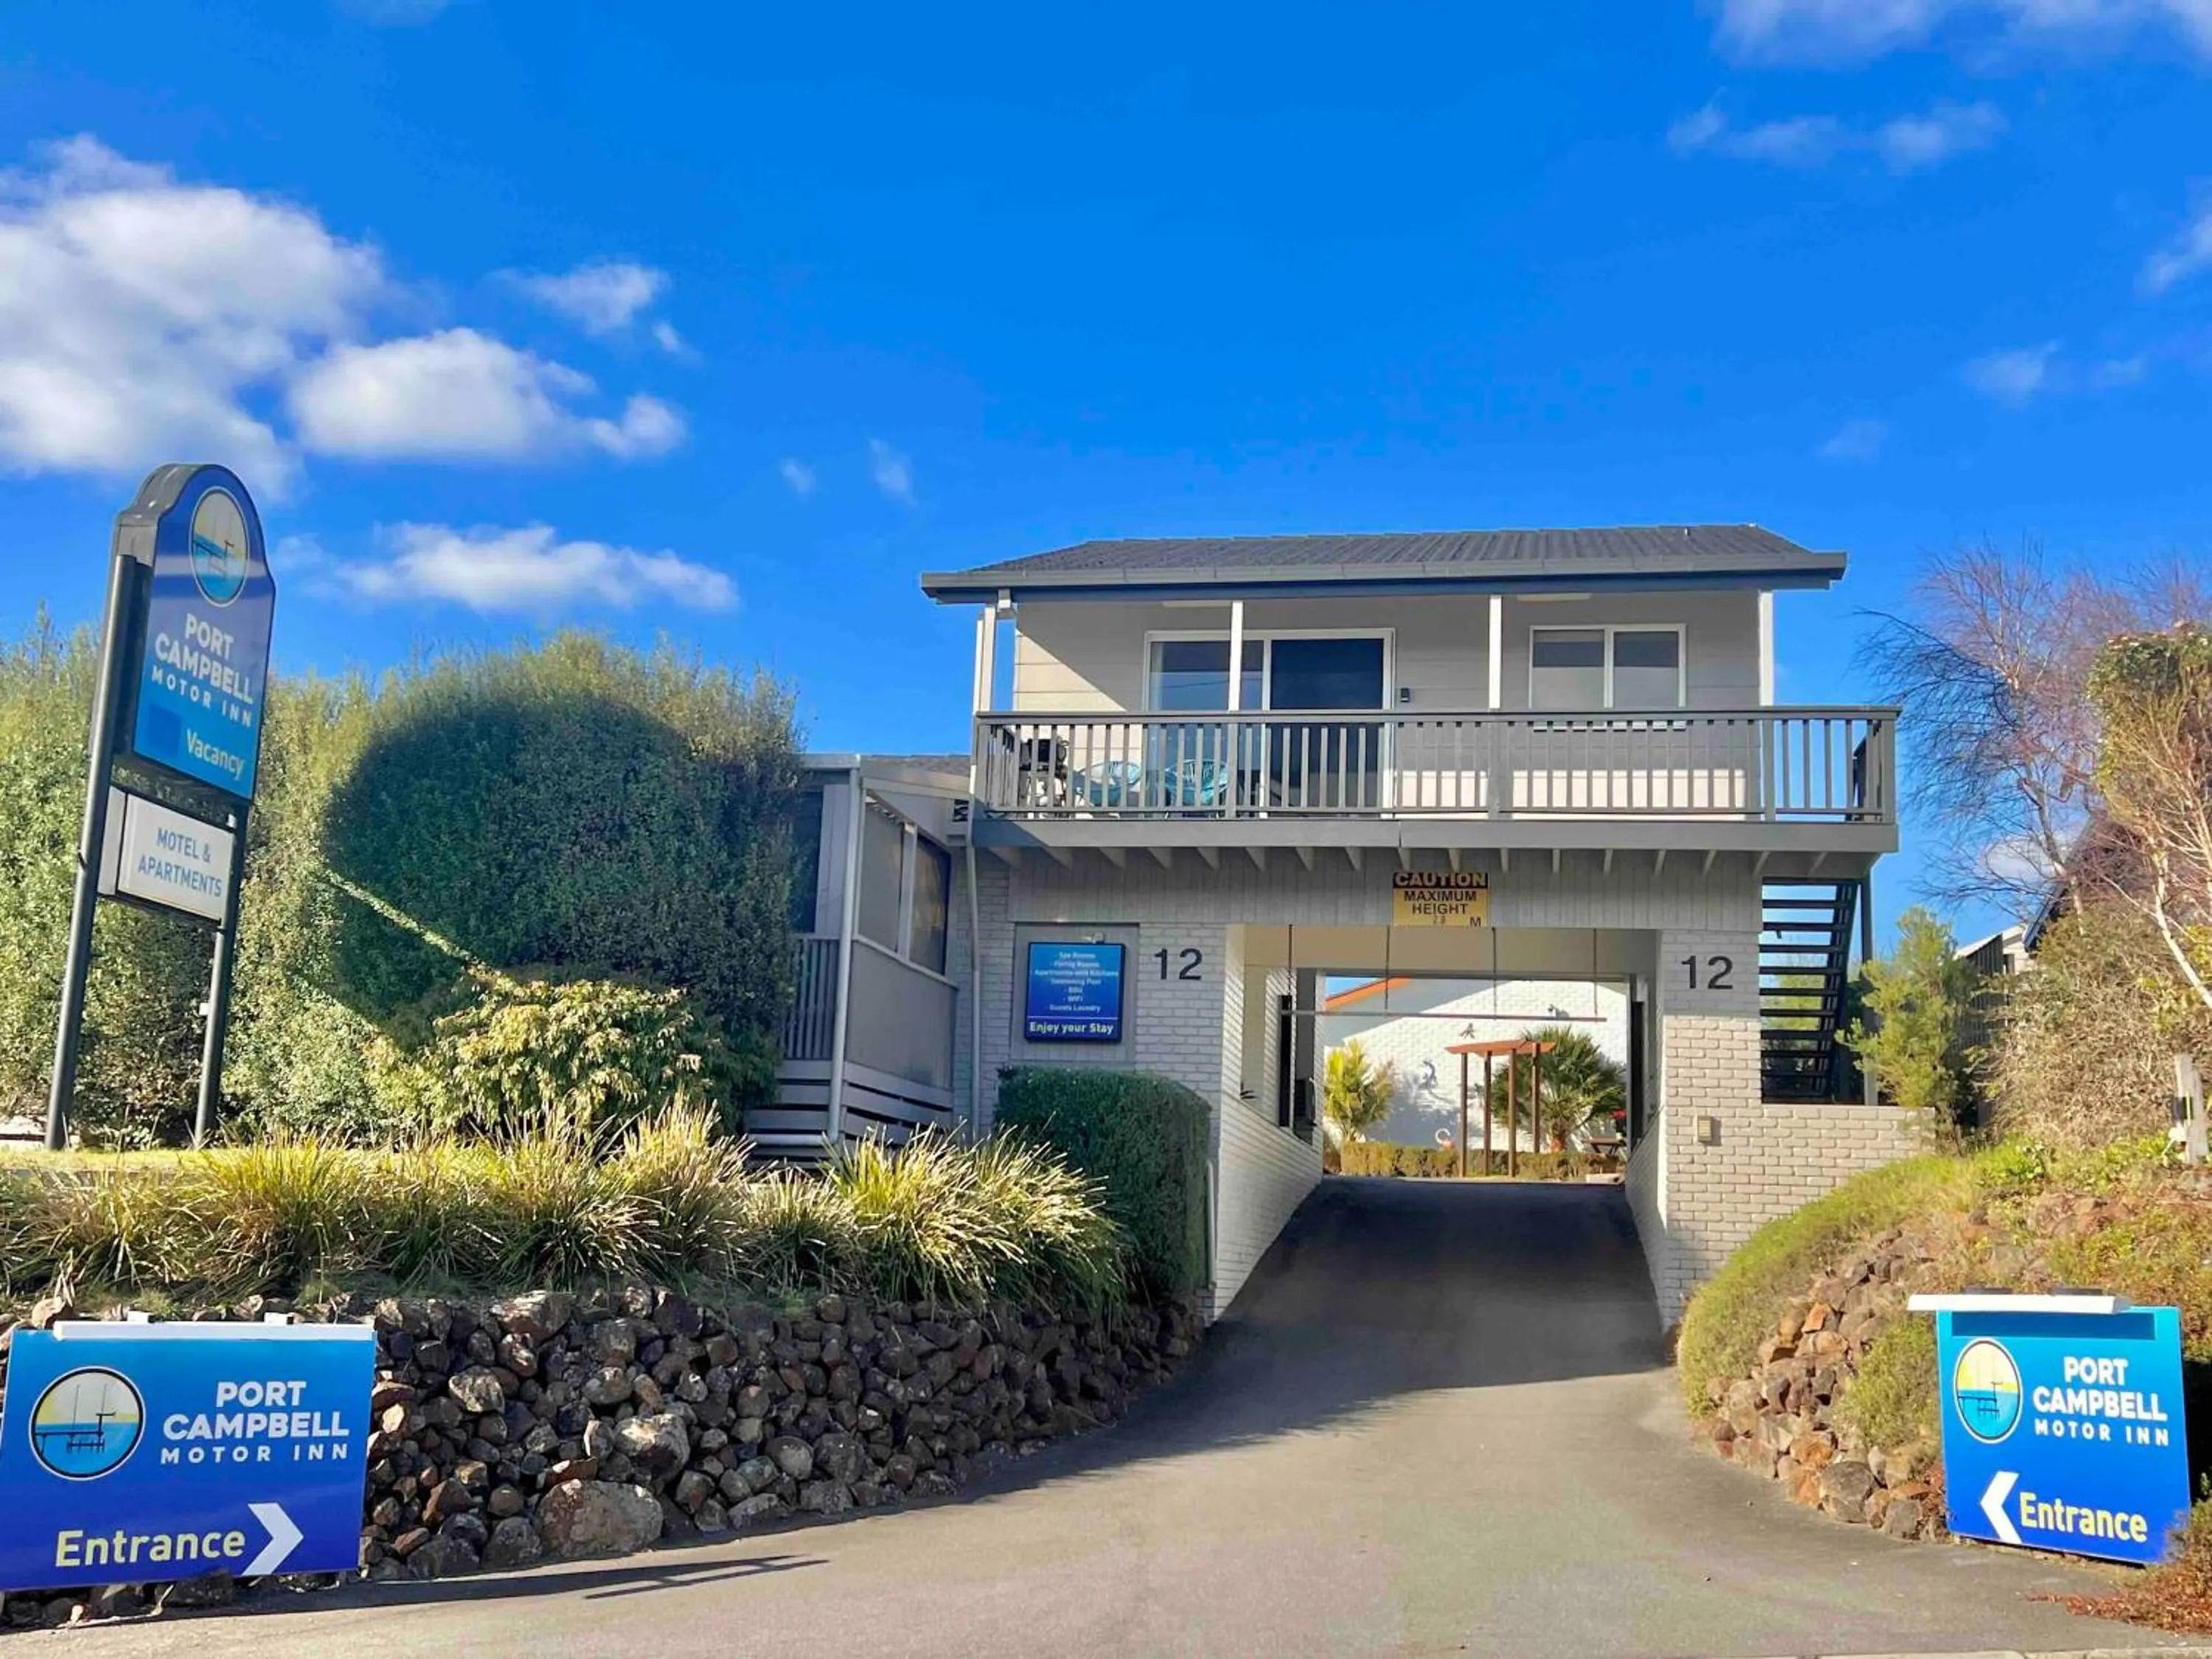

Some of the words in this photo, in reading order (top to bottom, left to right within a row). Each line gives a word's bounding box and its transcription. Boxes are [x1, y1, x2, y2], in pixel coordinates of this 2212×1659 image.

[186, 613, 234, 661] PORT
[155, 633, 254, 704] CAMPBELL
[152, 665, 211, 709] MOTOR
[222, 700, 251, 727] INN
[187, 728, 245, 780] Vacancy
[156, 827, 199, 860] MOTEL
[202, 843, 211, 863] &
[137, 853, 223, 897] APARTMENTS
[1394, 872, 1486, 886] CAUTION
[1404, 890, 1477, 902] MAXIMUM
[1412, 903, 1469, 915] HEIGHT
[1470, 917, 1481, 927] M
[1154, 948, 1203, 980] 12
[1681, 955, 1733, 990] 12
[1029, 1022, 1060, 1034] Enjoy
[1061, 1024, 1086, 1034] your
[1090, 1023, 1113, 1035] Stay
[2064, 1356, 2129, 1385] PORT
[215, 1380, 307, 1408] PORT
[2032, 1386, 2168, 1422] CAMPBELL
[162, 1411, 350, 1441] CAMPBELL
[2034, 1418, 2111, 1441] MOTOR
[2126, 1426, 2168, 1446] INN
[160, 1445, 271, 1464] MOTOR
[293, 1443, 348, 1461] INN
[2019, 1492, 2148, 1543] Entrance
[55, 1529, 246, 1568] Entrance
